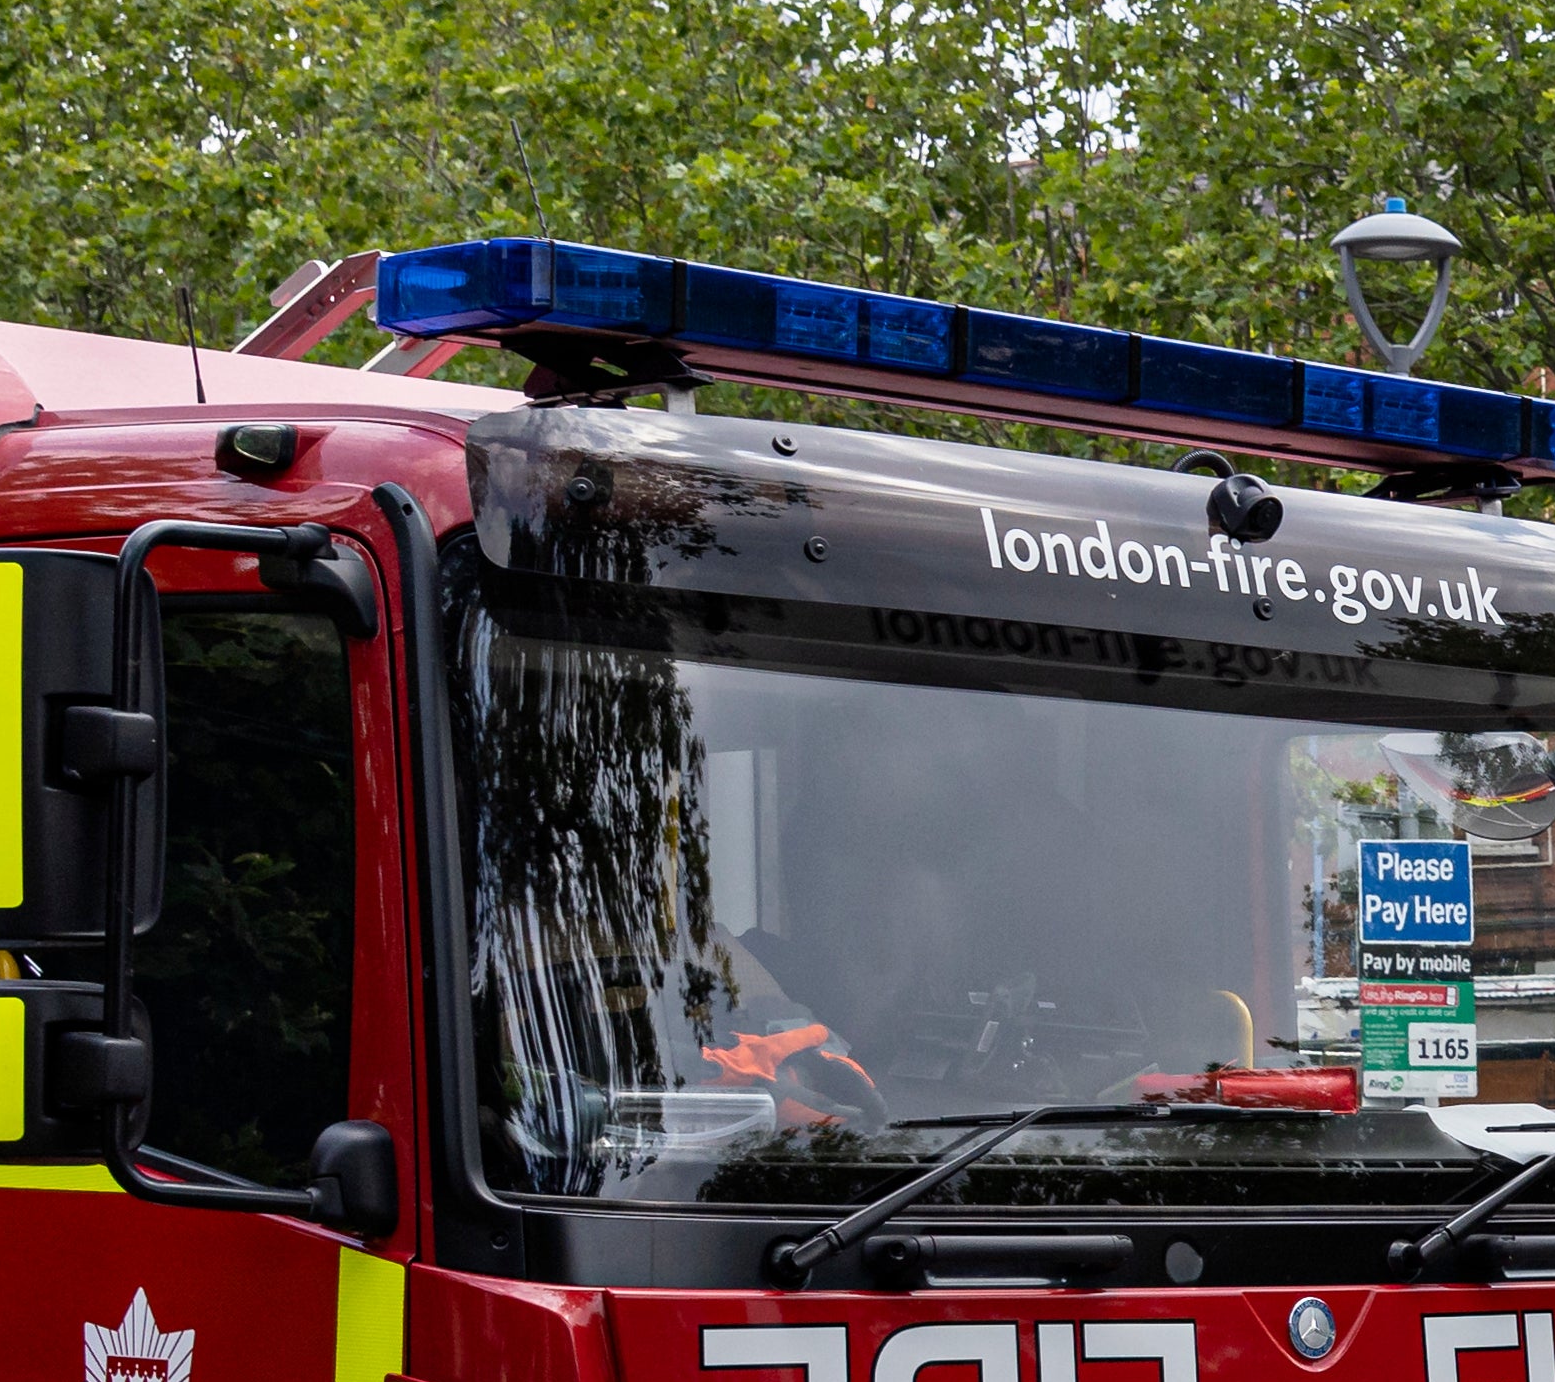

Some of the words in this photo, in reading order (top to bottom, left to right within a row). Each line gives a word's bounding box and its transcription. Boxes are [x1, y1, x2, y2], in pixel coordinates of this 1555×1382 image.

[980, 508, 1505, 625] london-fire.gov.uk
[1377, 851, 1454, 882] Please
[1364, 894, 1409, 932] Pay
[1414, 894, 1468, 926] Here
[1362, 952, 1393, 975] Pay
[1395, 952, 1416, 975] by
[1419, 954, 1472, 973] mobile
[1418, 1037, 1470, 1060] 1165
